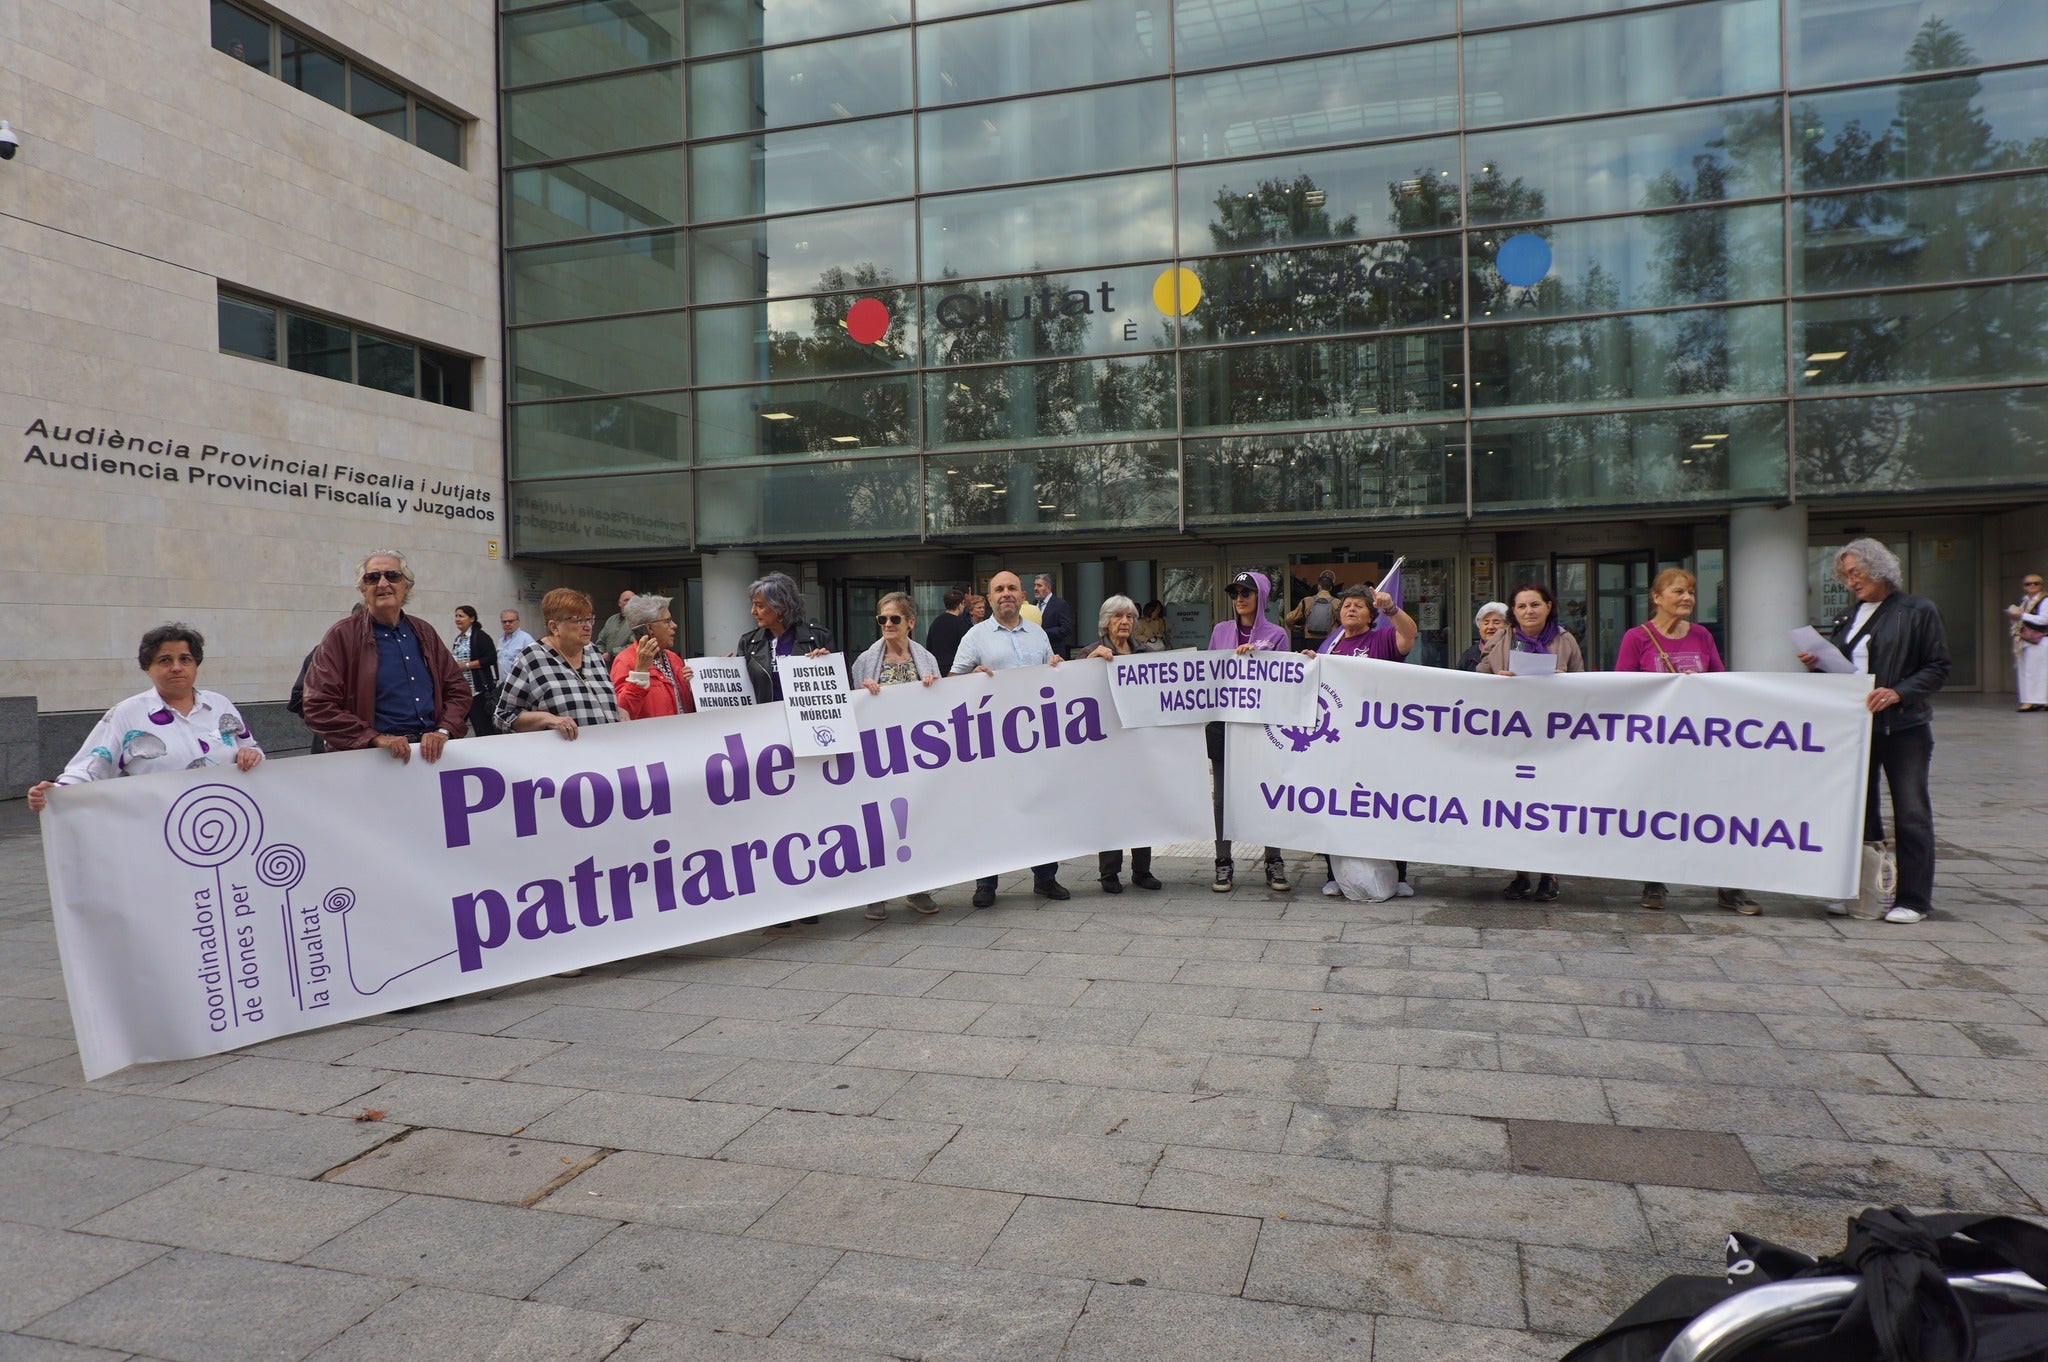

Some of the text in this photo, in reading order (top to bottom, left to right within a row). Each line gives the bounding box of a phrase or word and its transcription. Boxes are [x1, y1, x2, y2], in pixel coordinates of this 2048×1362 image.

[936, 281, 1115, 329] Ciutat
[24, 418, 491, 502] Audiència Provincial Fiscalia i Jutjats
[24, 445, 495, 522] Audiencia Provincial Fiscalía y Juzgados
[700, 668, 741, 680] ¡JUSTICIA
[704, 682, 743, 693] PARA LAS
[793, 665, 836, 678] JUSTÍCIA
[794, 680, 838, 692] PER A LES
[1117, 654, 1305, 686] FARTES DE VIOLÈNCIES
[700, 696, 752, 708] MENORES DE
[789, 693, 848, 708] XIQUETES DE
[800, 708, 842, 721] MÚRCIA!
[1160, 687, 1262, 712] MASCLISTES!
[1354, 699, 1826, 754] JUSTÍCIA PATRIARCAL
[438, 761, 672, 849] Prou
[705, 732, 796, 806] de
[1260, 782, 1824, 853] VIOLÈNCIA INSTITUCIONAL
[452, 796, 912, 974] patriarcal!
[192, 888, 228, 1032] coordinadora
[232, 883, 264, 1022] de dones per
[300, 904, 332, 1010] la igualtat
